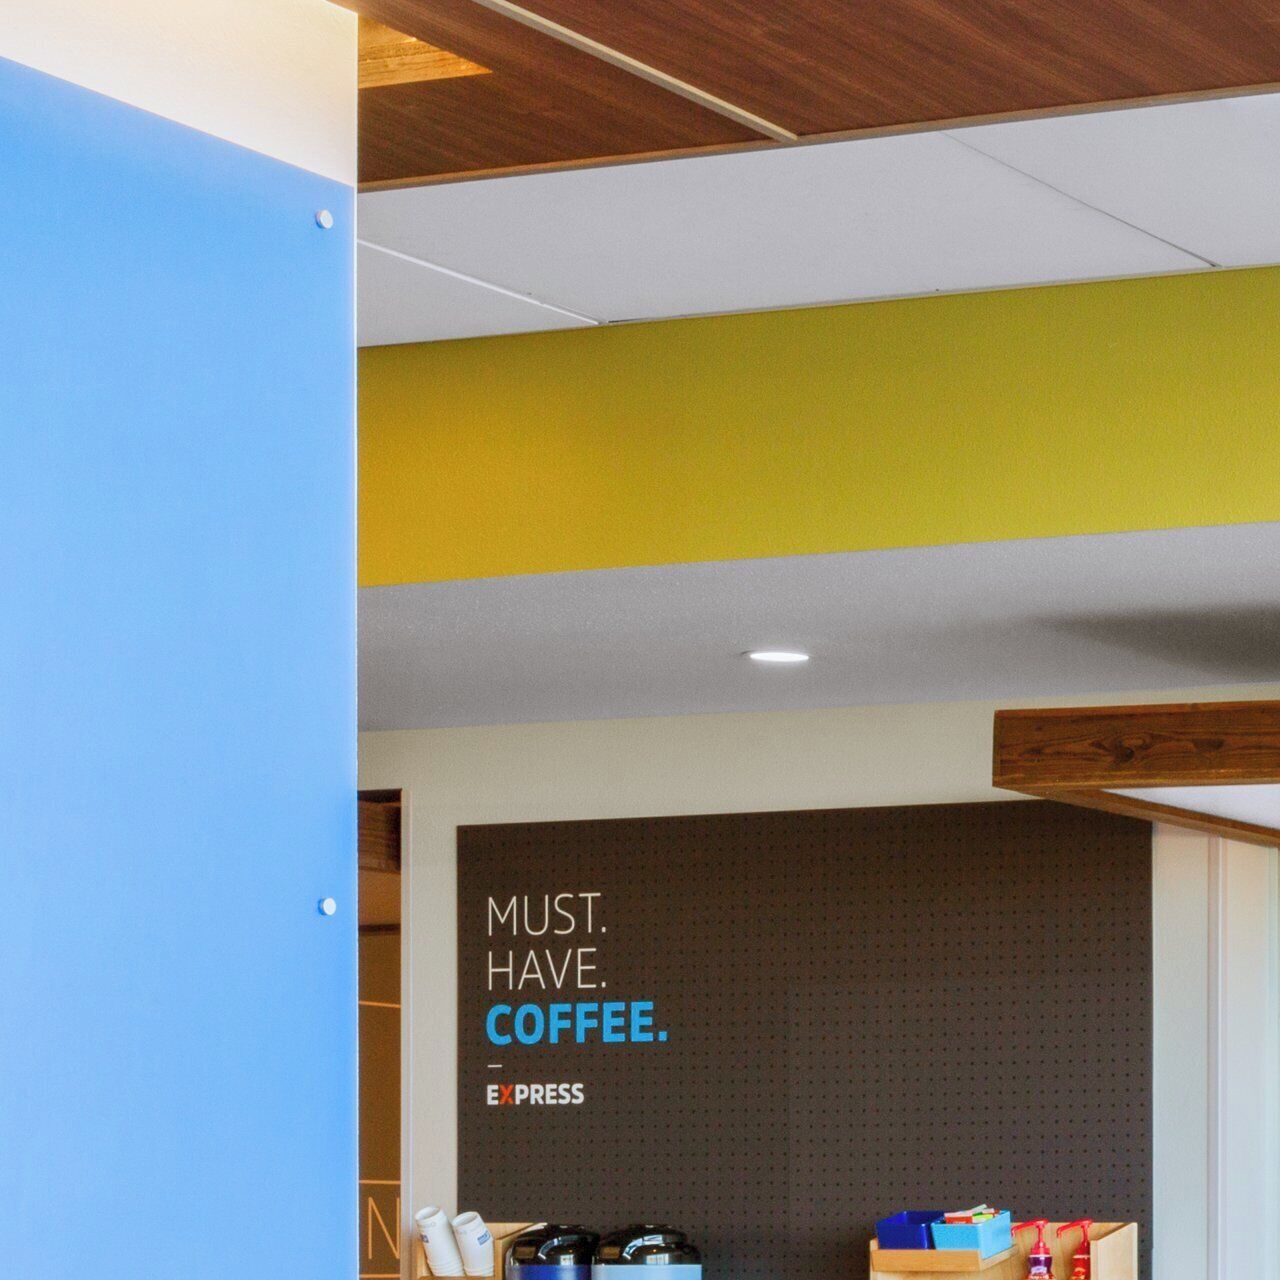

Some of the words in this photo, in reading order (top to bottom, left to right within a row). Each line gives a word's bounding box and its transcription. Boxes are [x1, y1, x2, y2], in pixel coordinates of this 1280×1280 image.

[488, 892, 607, 937] MUST.
[488, 947, 607, 991] HAVE.
[485, 1001, 668, 1046] COFFEE.
[487, 1082, 585, 1105] EXPRESS
